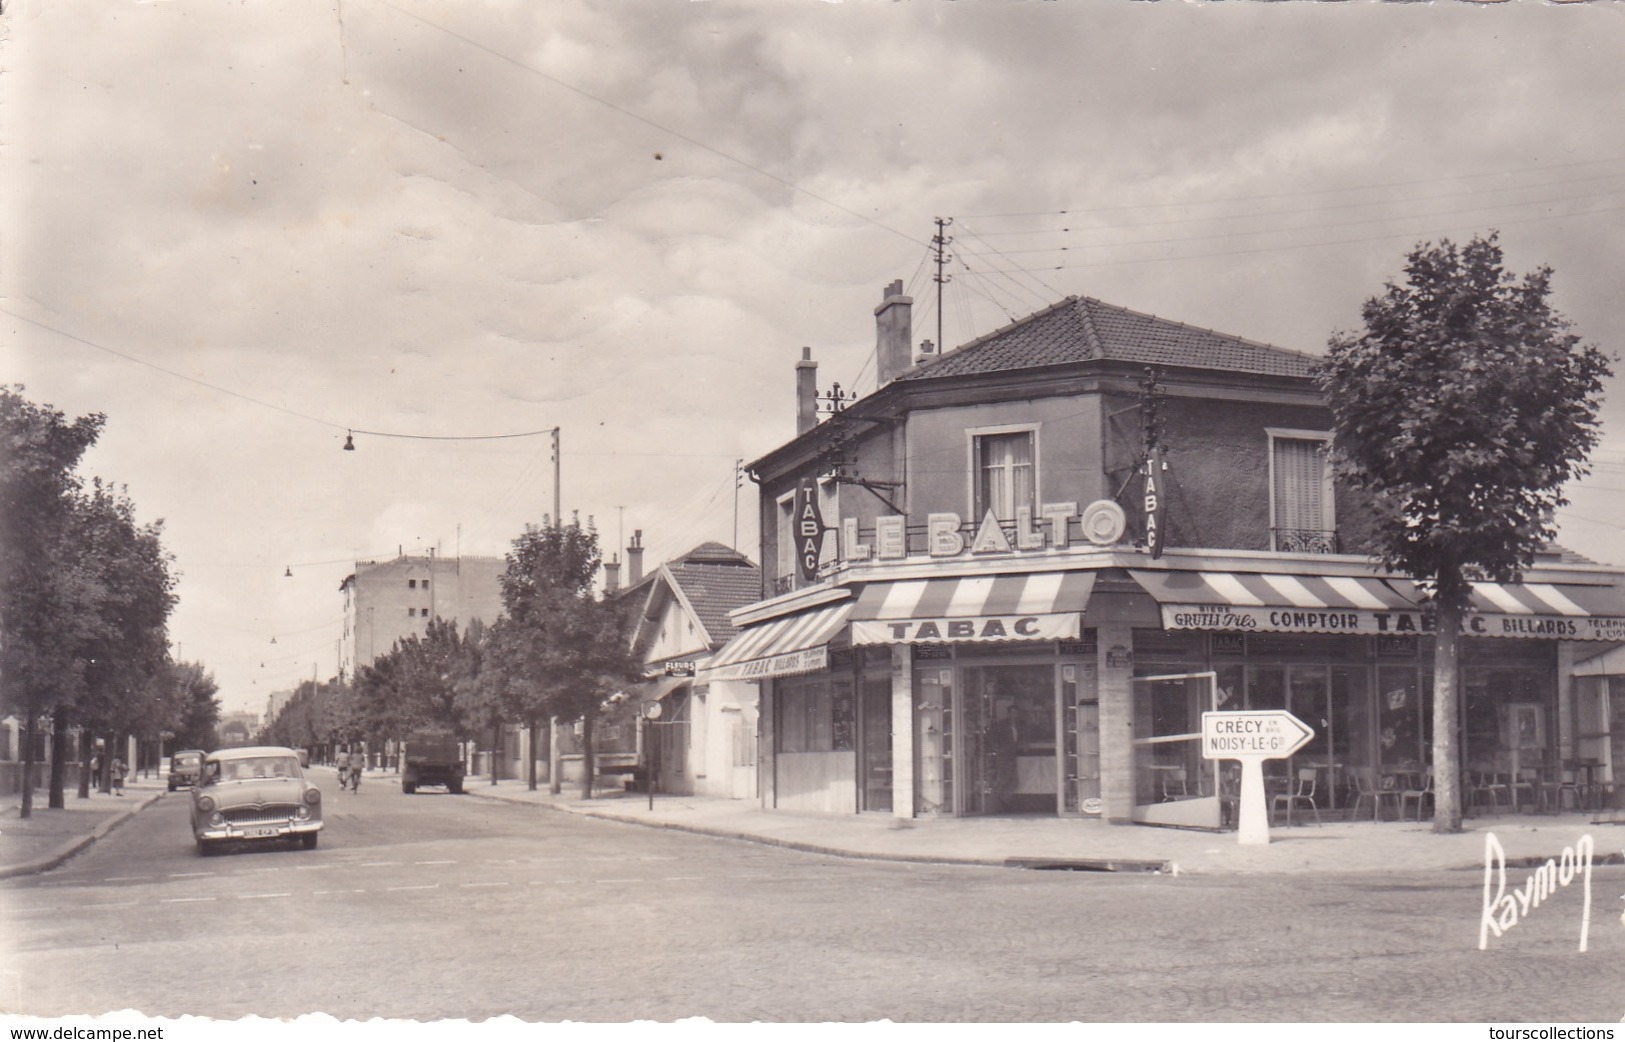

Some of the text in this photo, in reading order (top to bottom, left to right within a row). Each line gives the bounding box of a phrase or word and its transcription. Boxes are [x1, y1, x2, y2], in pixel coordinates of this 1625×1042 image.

[1144, 459, 1158, 548] TABAC
[800, 487, 819, 570] TABAC
[844, 499, 1126, 560] LE BALTO
[887, 617, 1040, 639] TABAC
[1222, 613, 1257, 629] Pils
[1269, 611, 1359, 629] COMPTOIR
[1502, 618, 1577, 635] BILLARDS
[665, 661, 695, 671] FLEURS
[741, 658, 771, 676] TABAC
[1216, 717, 1263, 733] CRÉCY
